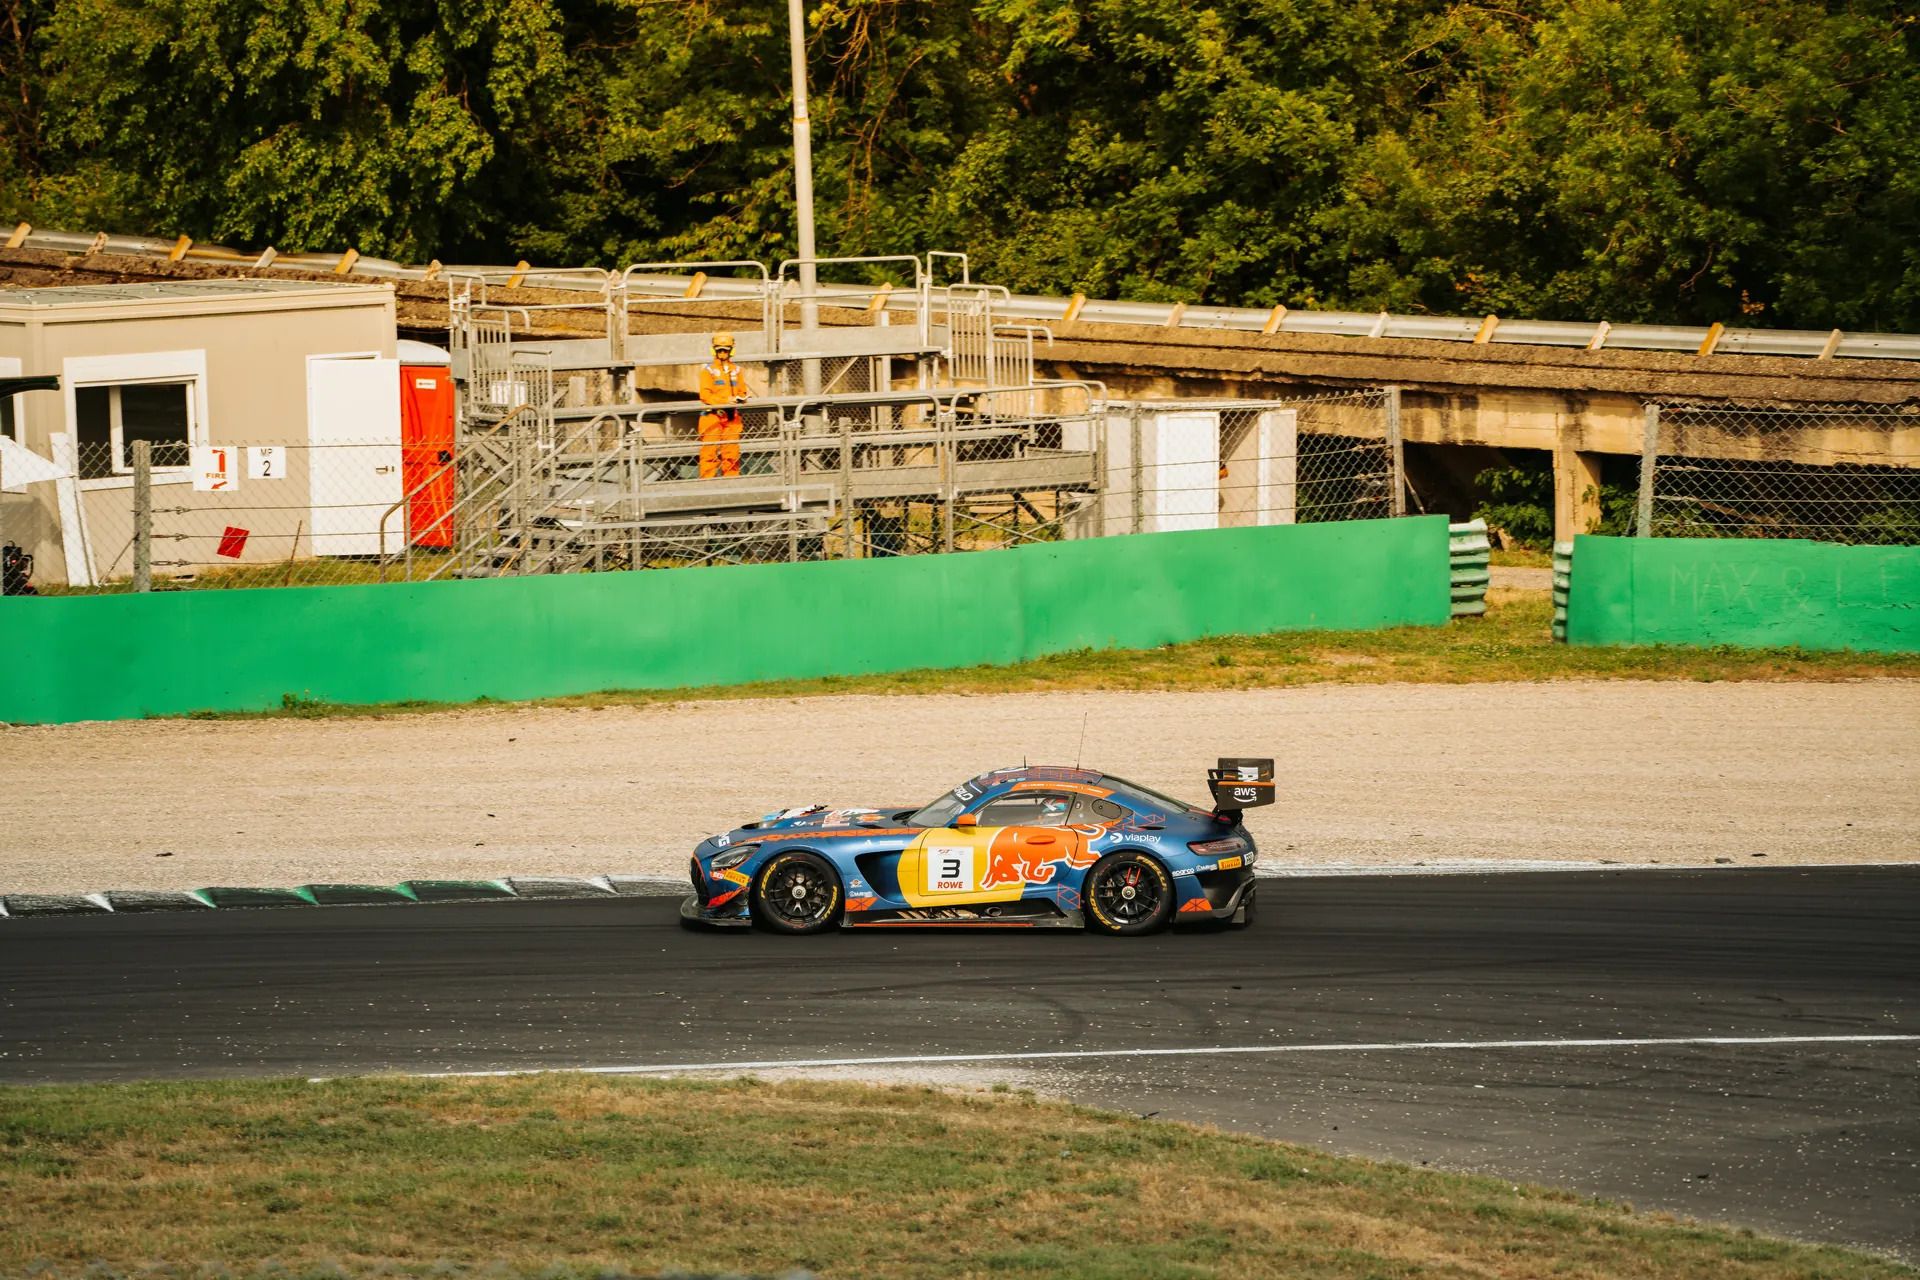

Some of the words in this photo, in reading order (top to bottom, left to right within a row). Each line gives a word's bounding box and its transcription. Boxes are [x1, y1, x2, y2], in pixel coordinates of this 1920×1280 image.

[263, 460, 271, 476] 2
[1670, 560, 1758, 614] MAX
[1234, 787, 1257, 796] aws
[1124, 833, 1161, 845] viaplay
[941, 859, 961, 879] 3
[937, 881, 964, 889] ROWE
